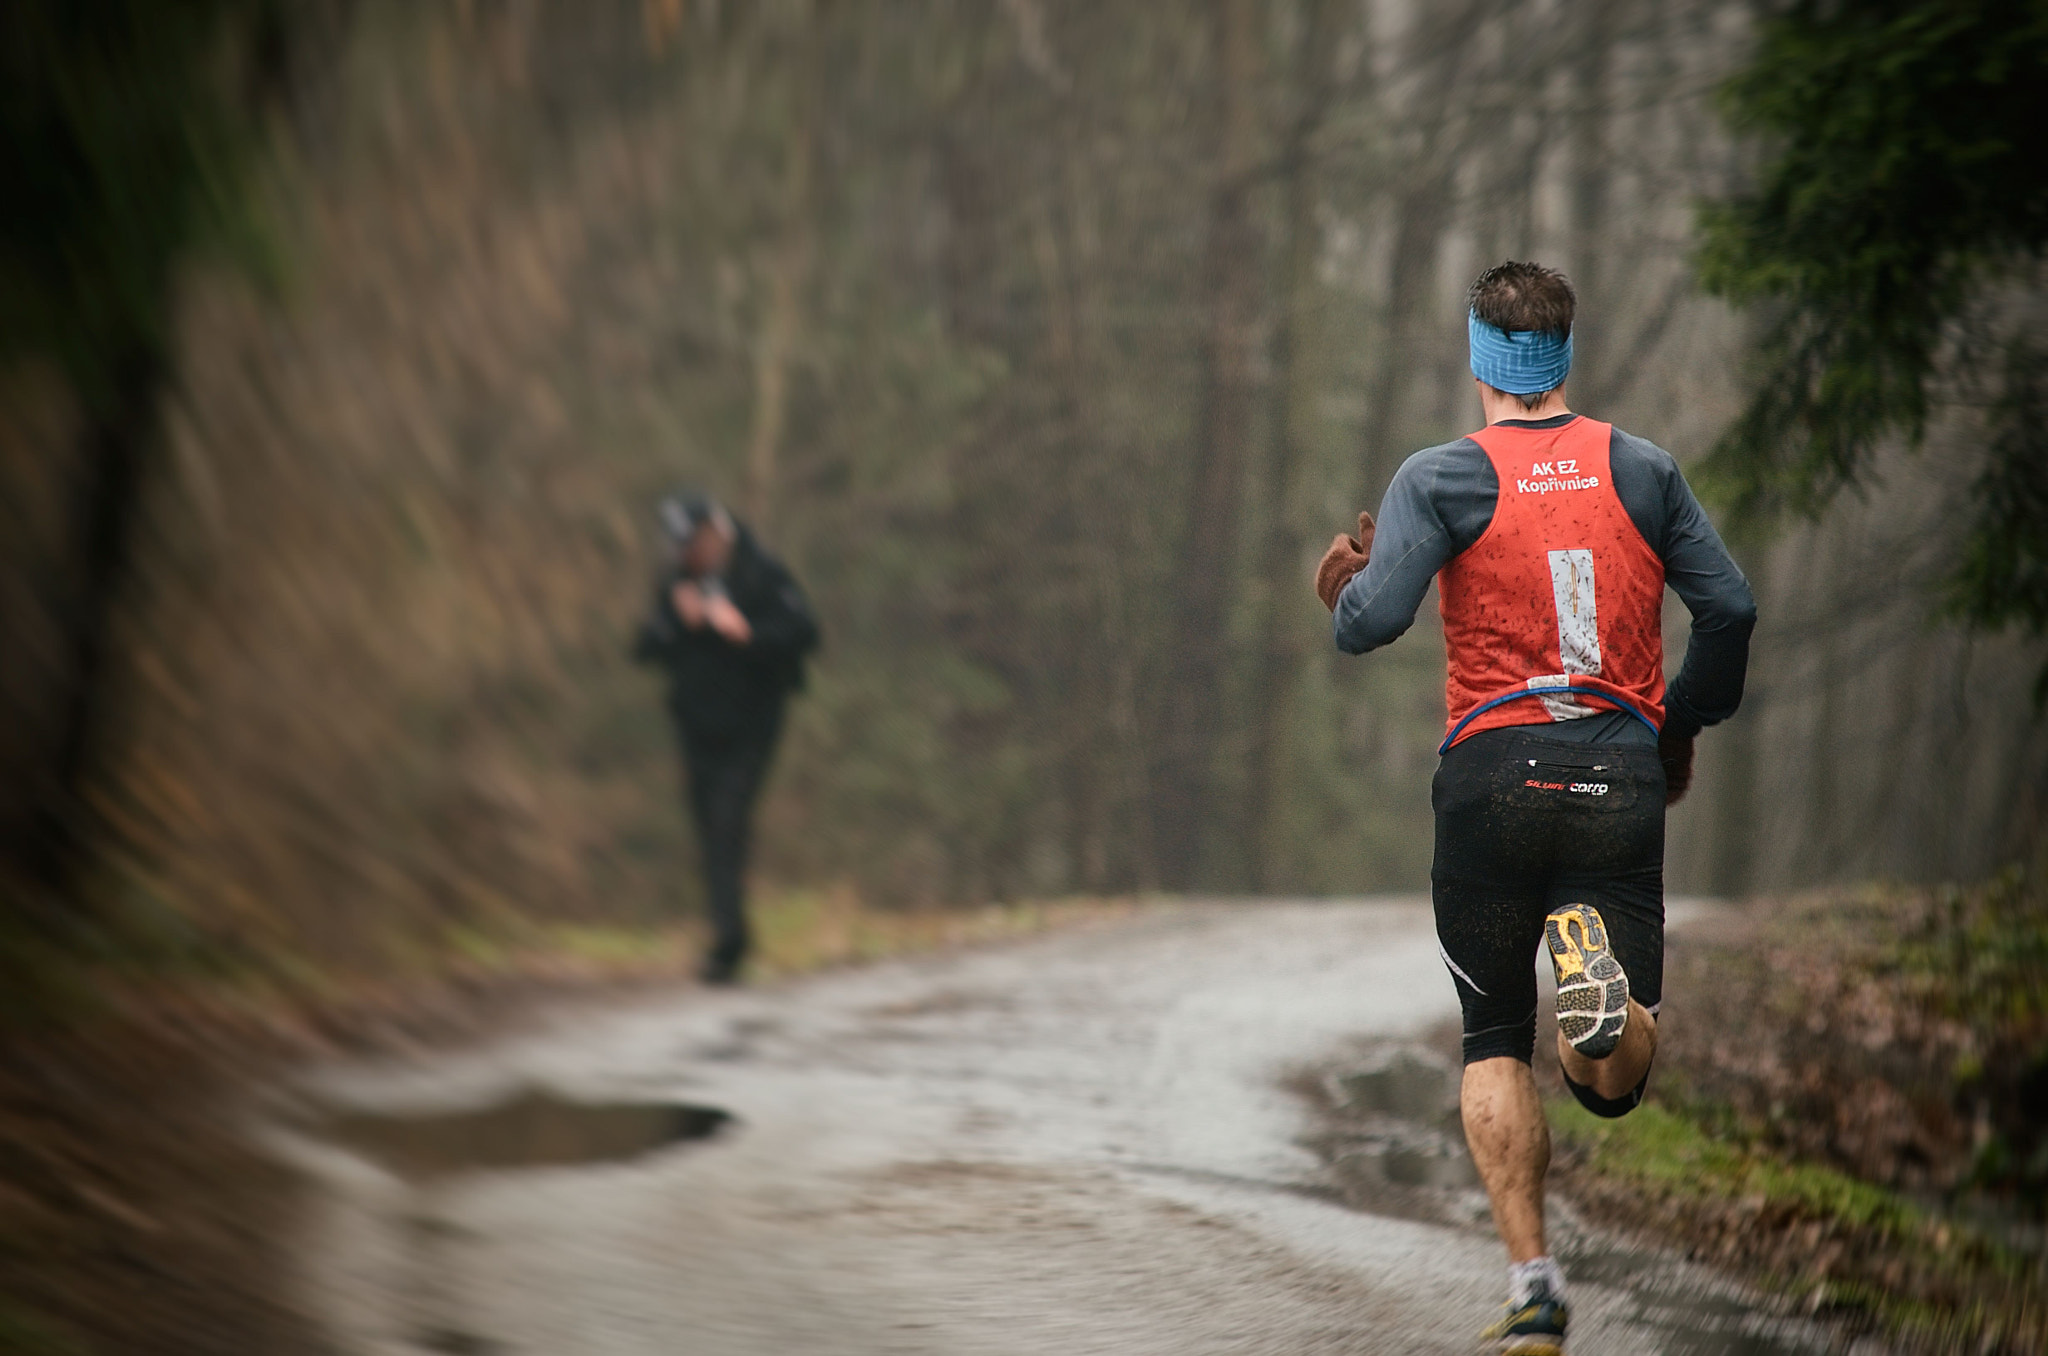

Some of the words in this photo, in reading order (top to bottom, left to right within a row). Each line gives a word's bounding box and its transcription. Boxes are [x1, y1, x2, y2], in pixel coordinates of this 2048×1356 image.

[1532, 462, 1555, 476] AK
[1557, 460, 1580, 475] EZ
[1517, 475, 1599, 495] Kopřivnice
